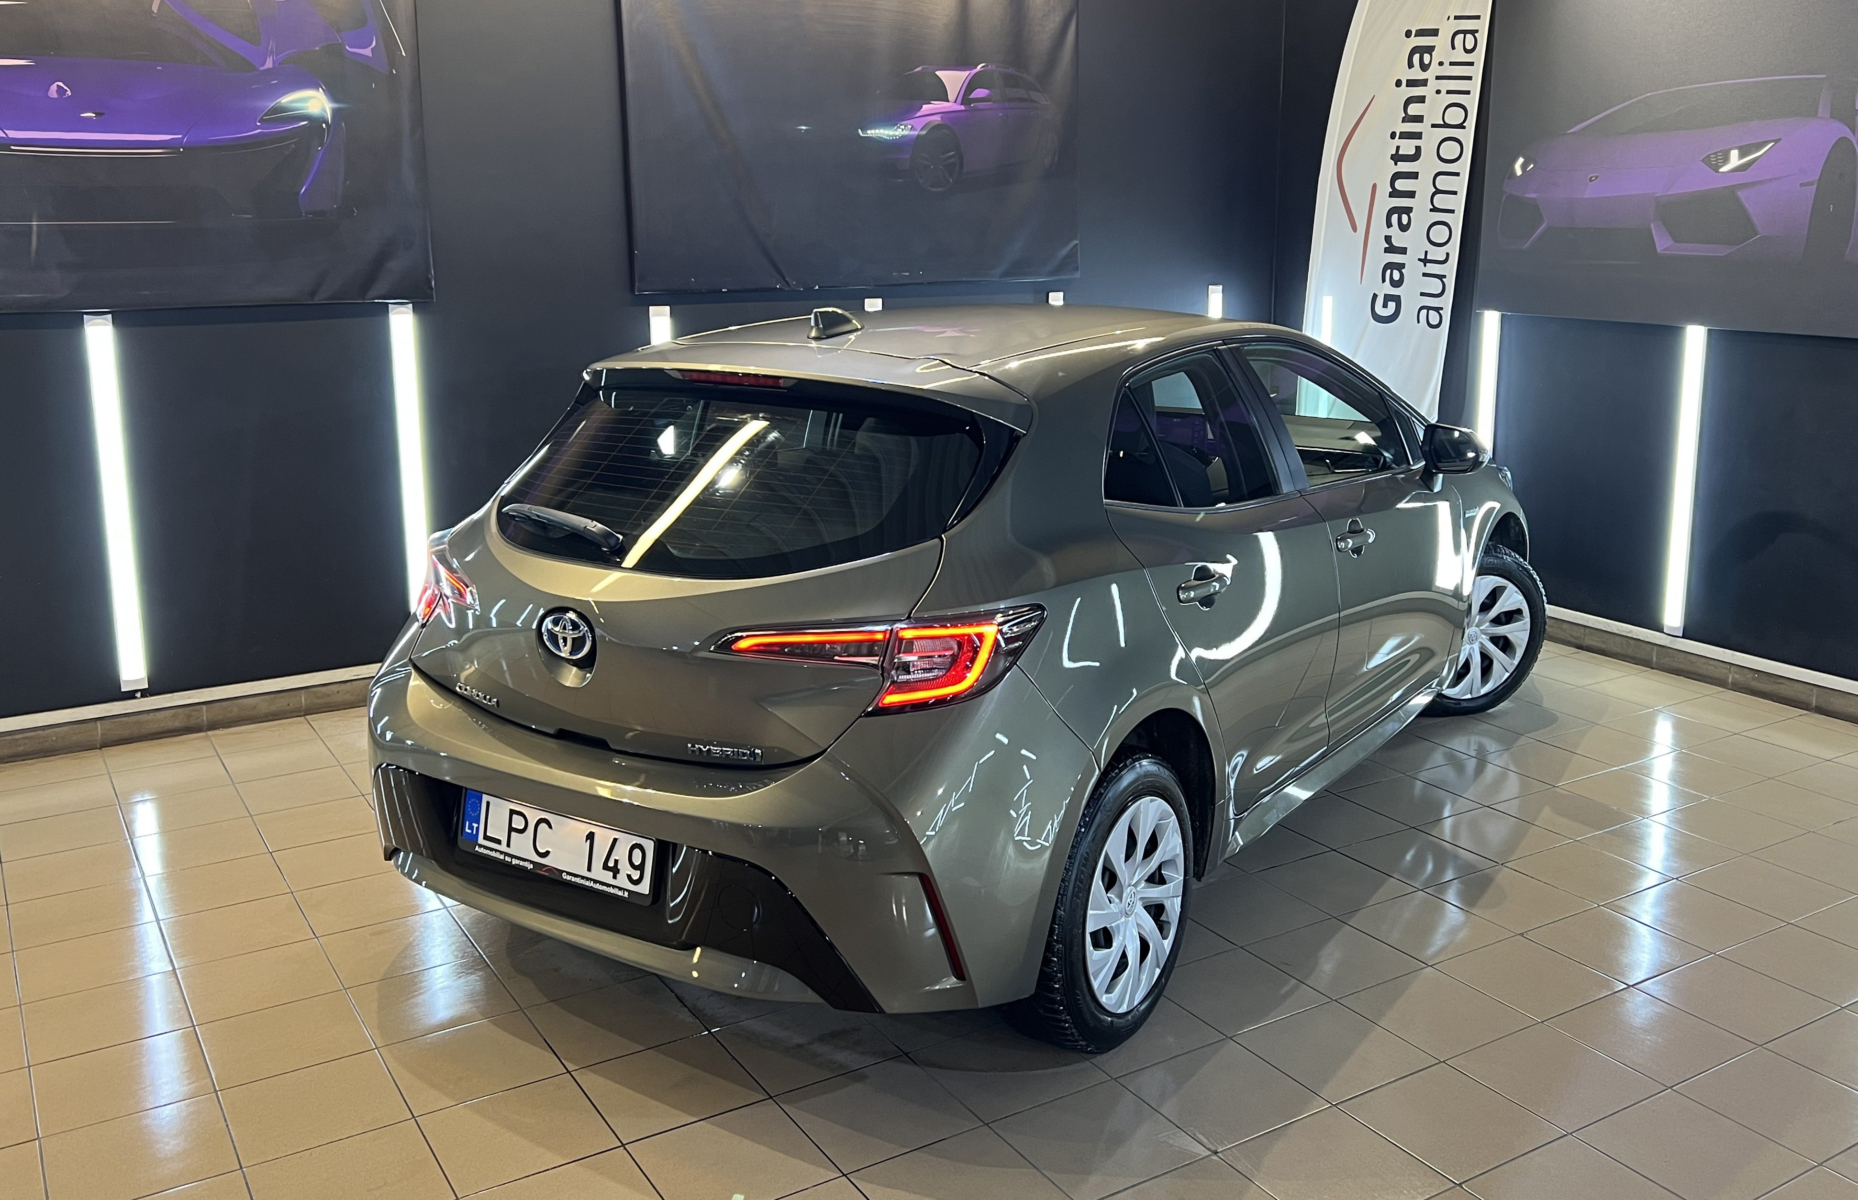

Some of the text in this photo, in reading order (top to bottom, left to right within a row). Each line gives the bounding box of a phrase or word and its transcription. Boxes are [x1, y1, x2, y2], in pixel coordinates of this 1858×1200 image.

[1370, 27, 1440, 325] Garantiniai
[1416, 14, 1482, 330] automobiliai
[687, 743, 750, 760] HYBRID
[465, 822, 479, 835] LT
[474, 845, 505, 860] Automobiliai
[505, 855, 512, 863] su
[482, 800, 647, 886] LPC 149
